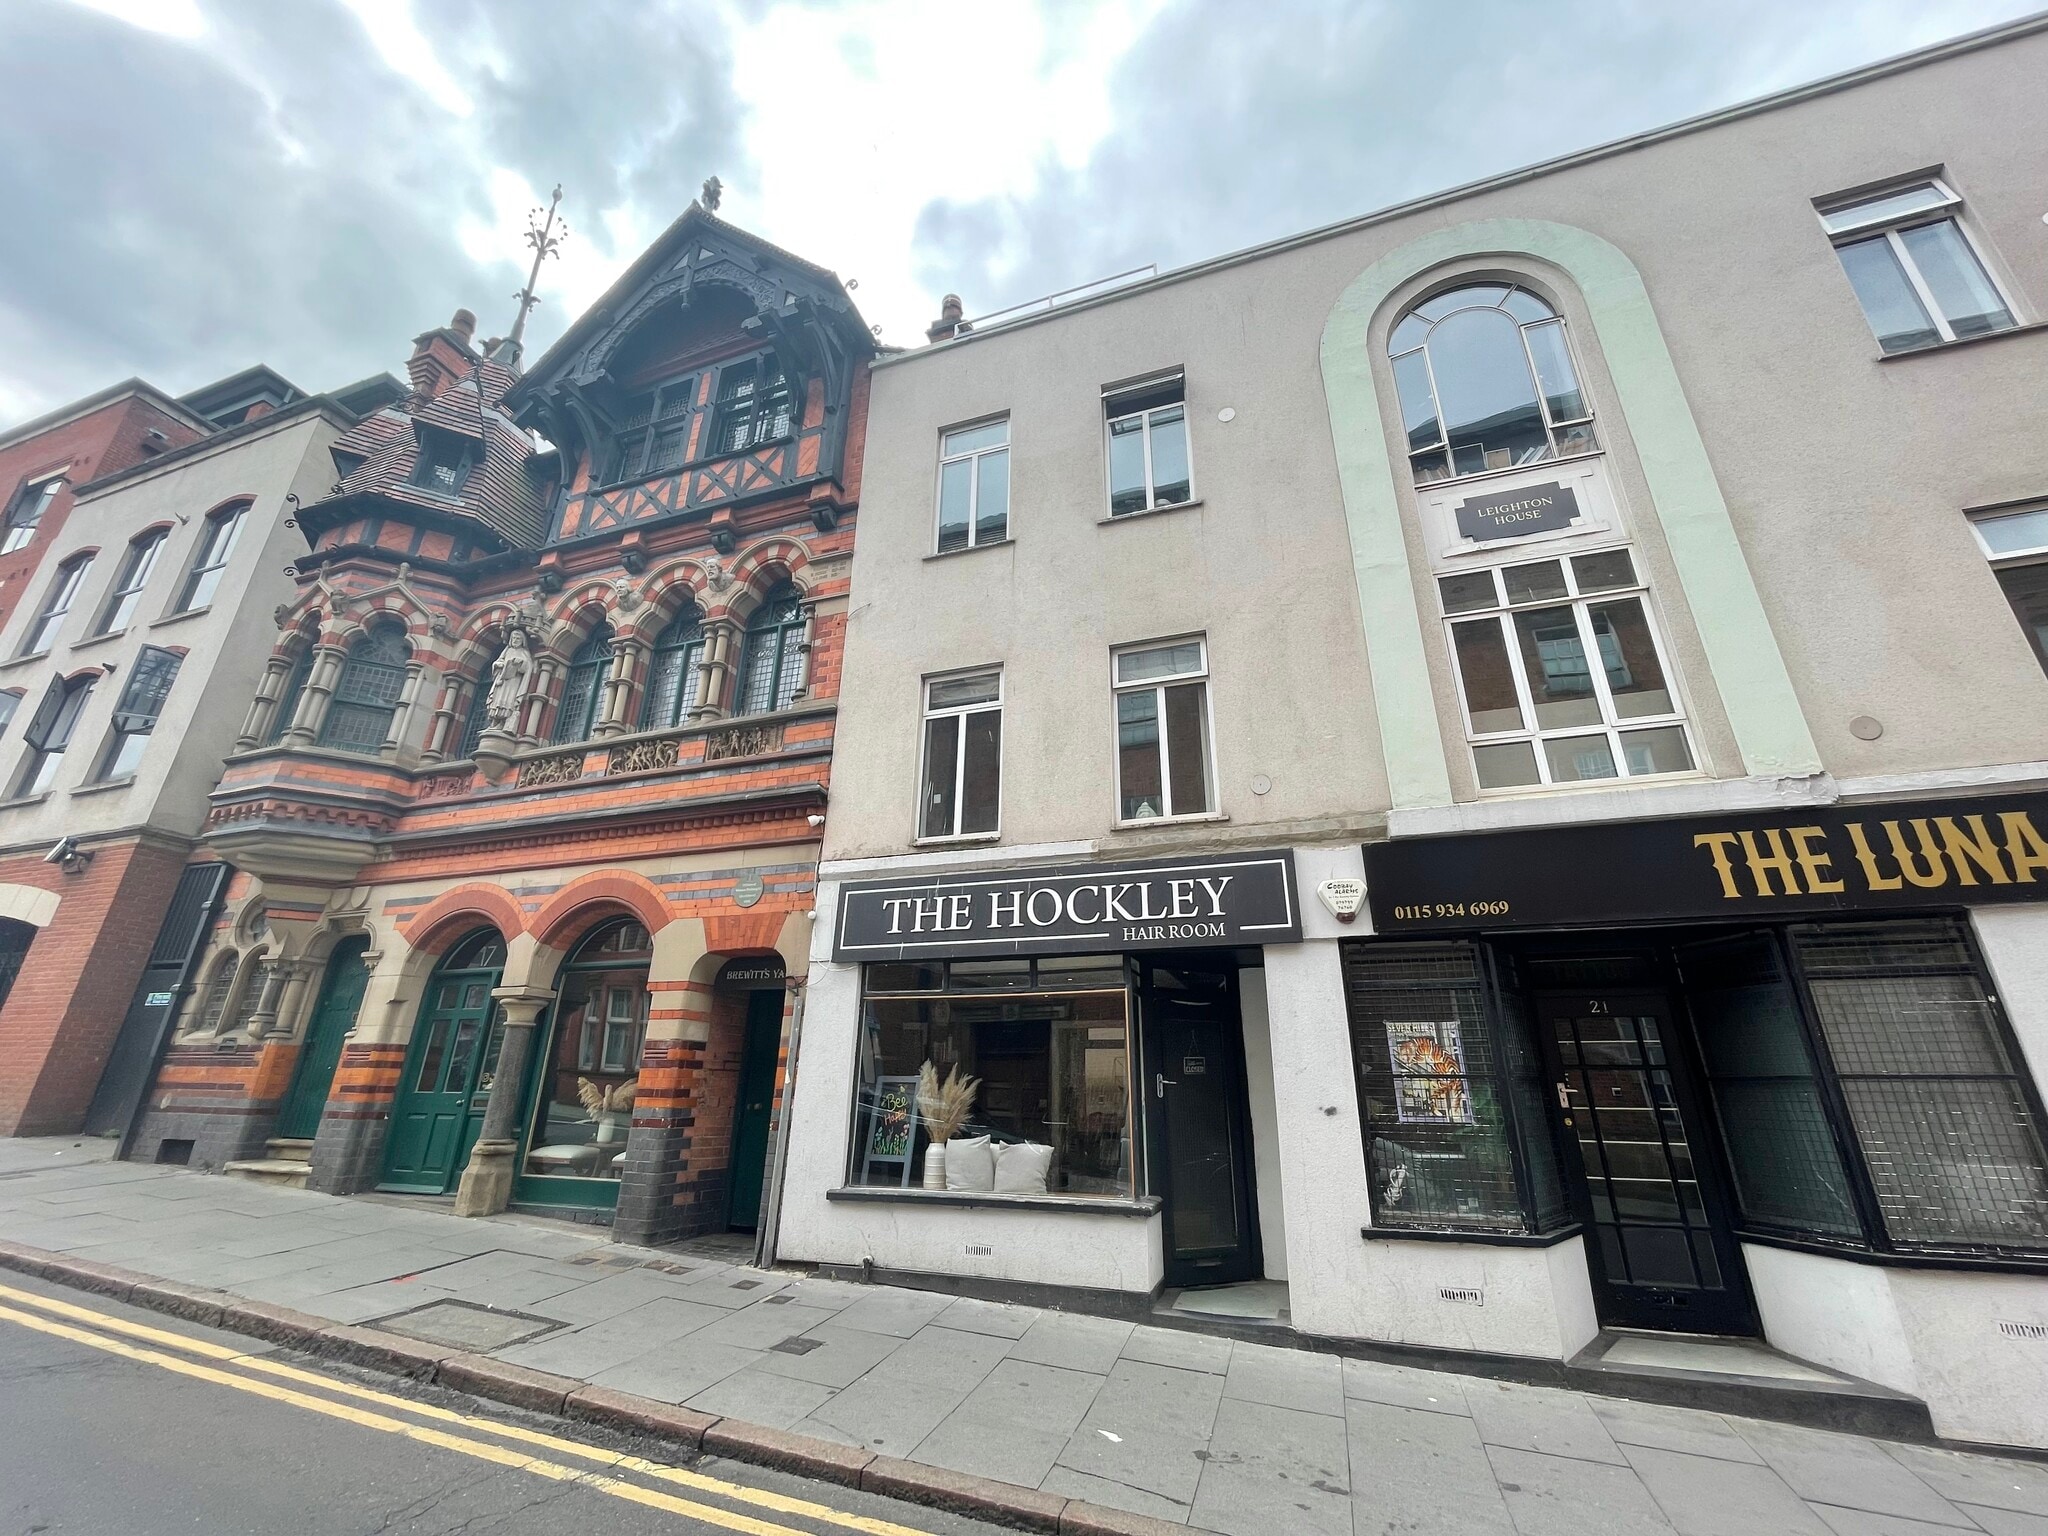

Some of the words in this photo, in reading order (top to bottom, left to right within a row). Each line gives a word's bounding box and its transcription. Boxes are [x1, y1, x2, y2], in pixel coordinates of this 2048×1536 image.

[1477, 496, 1553, 518] LEIGHTON
[1494, 509, 1542, 526] HOUSE
[1693, 826, 1844, 897] THE
[1844, 812, 2048, 891] LUNA
[882, 893, 973, 935] THE
[986, 876, 1233, 928] HOCKLEY
[1393, 904, 1432, 920] 0115
[1435, 903, 1466, 918] 934
[1469, 900, 1510, 917] 6969
[1122, 925, 1167, 942] HAIR
[1167, 922, 1227, 940] ROOM
[480, 945, 498, 966] 17
[1589, 1000, 1609, 1014] 21
[886, 1093, 908, 1112] Bee
